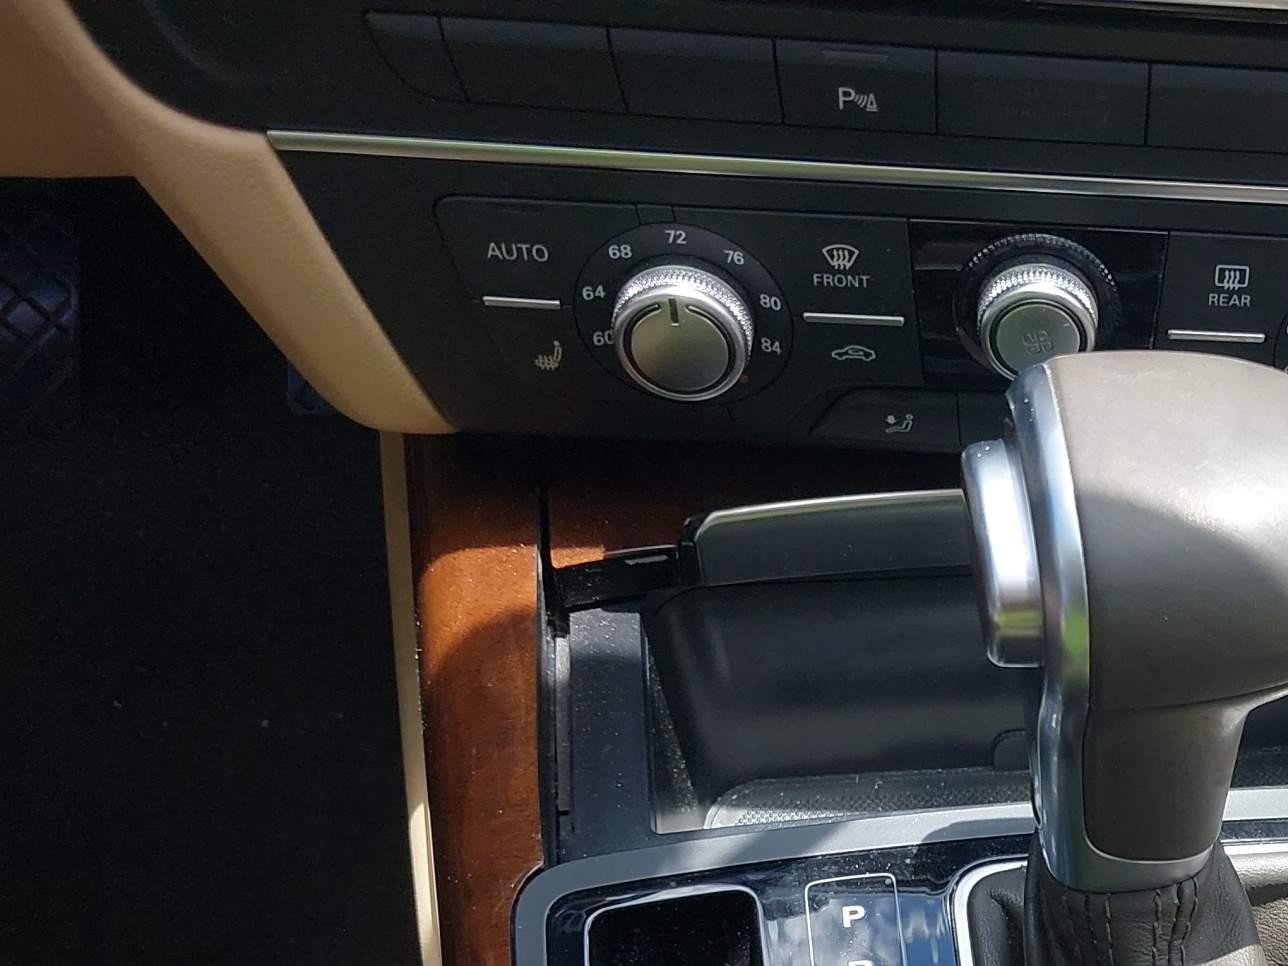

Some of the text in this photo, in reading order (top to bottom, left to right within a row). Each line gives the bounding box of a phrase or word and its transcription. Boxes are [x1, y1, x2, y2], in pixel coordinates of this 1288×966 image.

[665, 230, 687, 245] 72
[487, 242, 549, 262] AUTO
[608, 245, 632, 259] 68
[723, 250, 745, 265] 76
[813, 273, 871, 288] FRONT
[582, 285, 606, 300] 64
[1208, 293, 1251, 307] REAR
[760, 294, 783, 311] 80
[760, 338, 783, 355] 84
[842, 905, 866, 928] P
